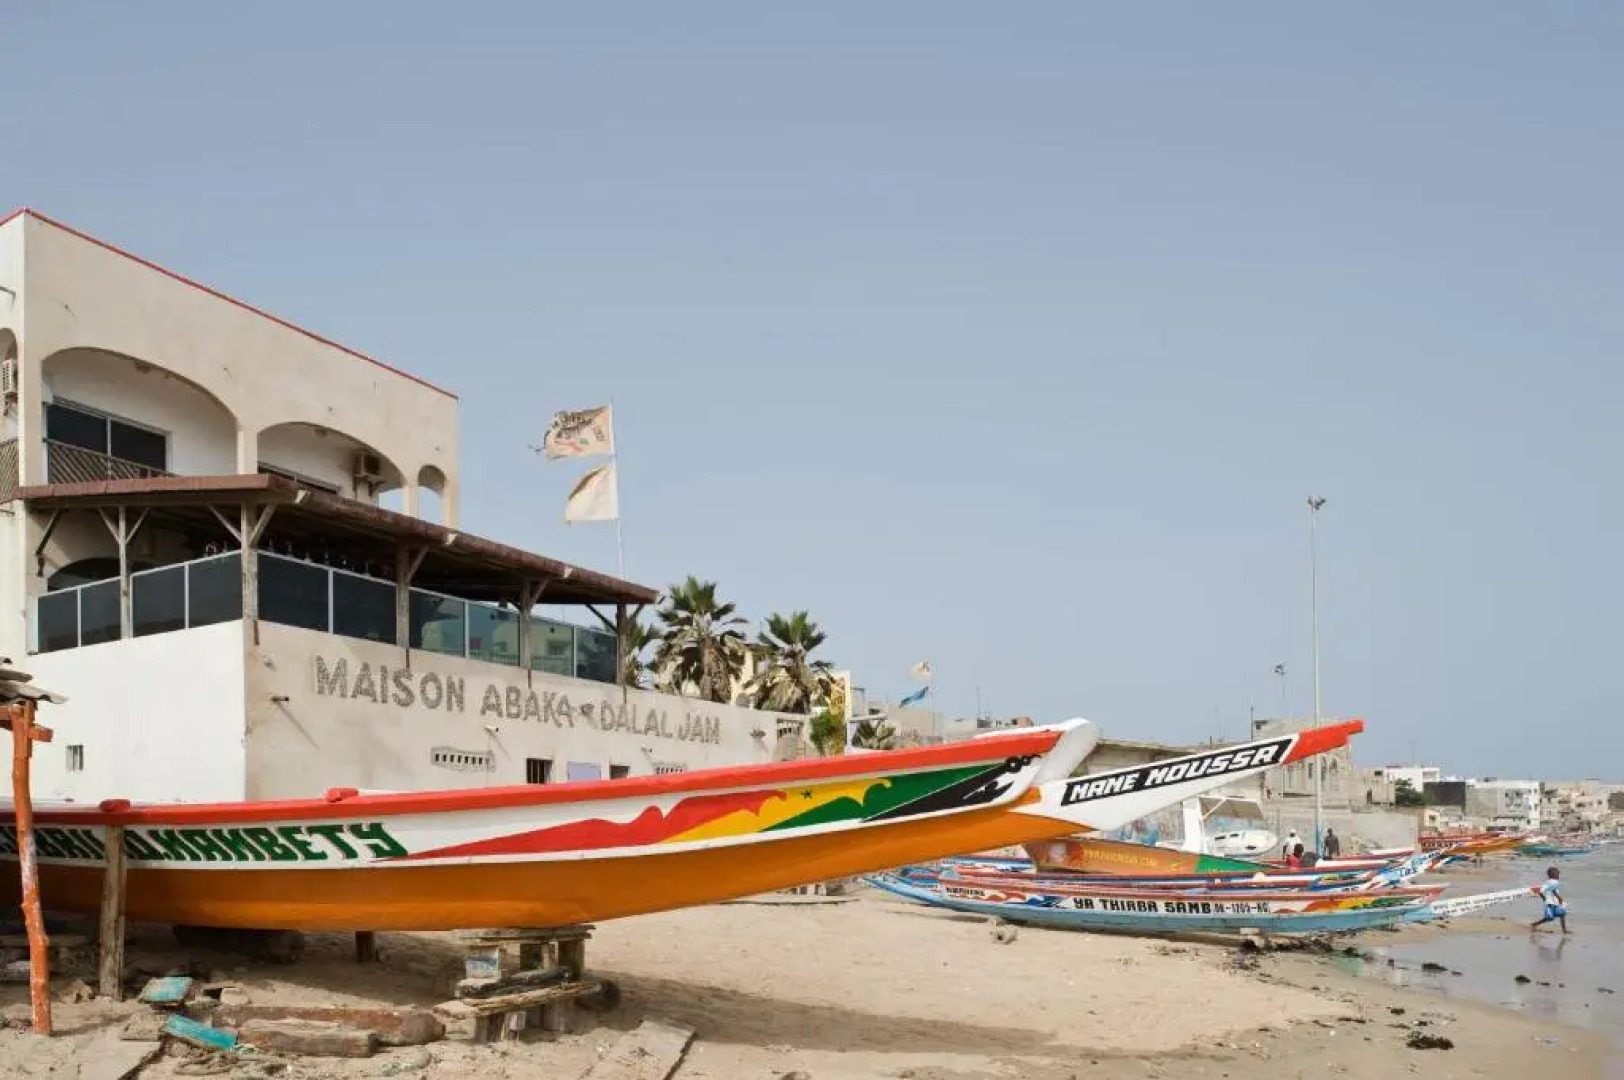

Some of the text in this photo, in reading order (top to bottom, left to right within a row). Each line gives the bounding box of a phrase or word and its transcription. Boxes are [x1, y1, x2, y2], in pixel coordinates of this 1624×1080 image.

[315, 655, 721, 744] MAISON ABAKA DALAL JAM
[1068, 745, 1281, 802] MAME MOUSSA
[1073, 897, 1094, 909] YA
[1164, 901, 1211, 914] SAMB
